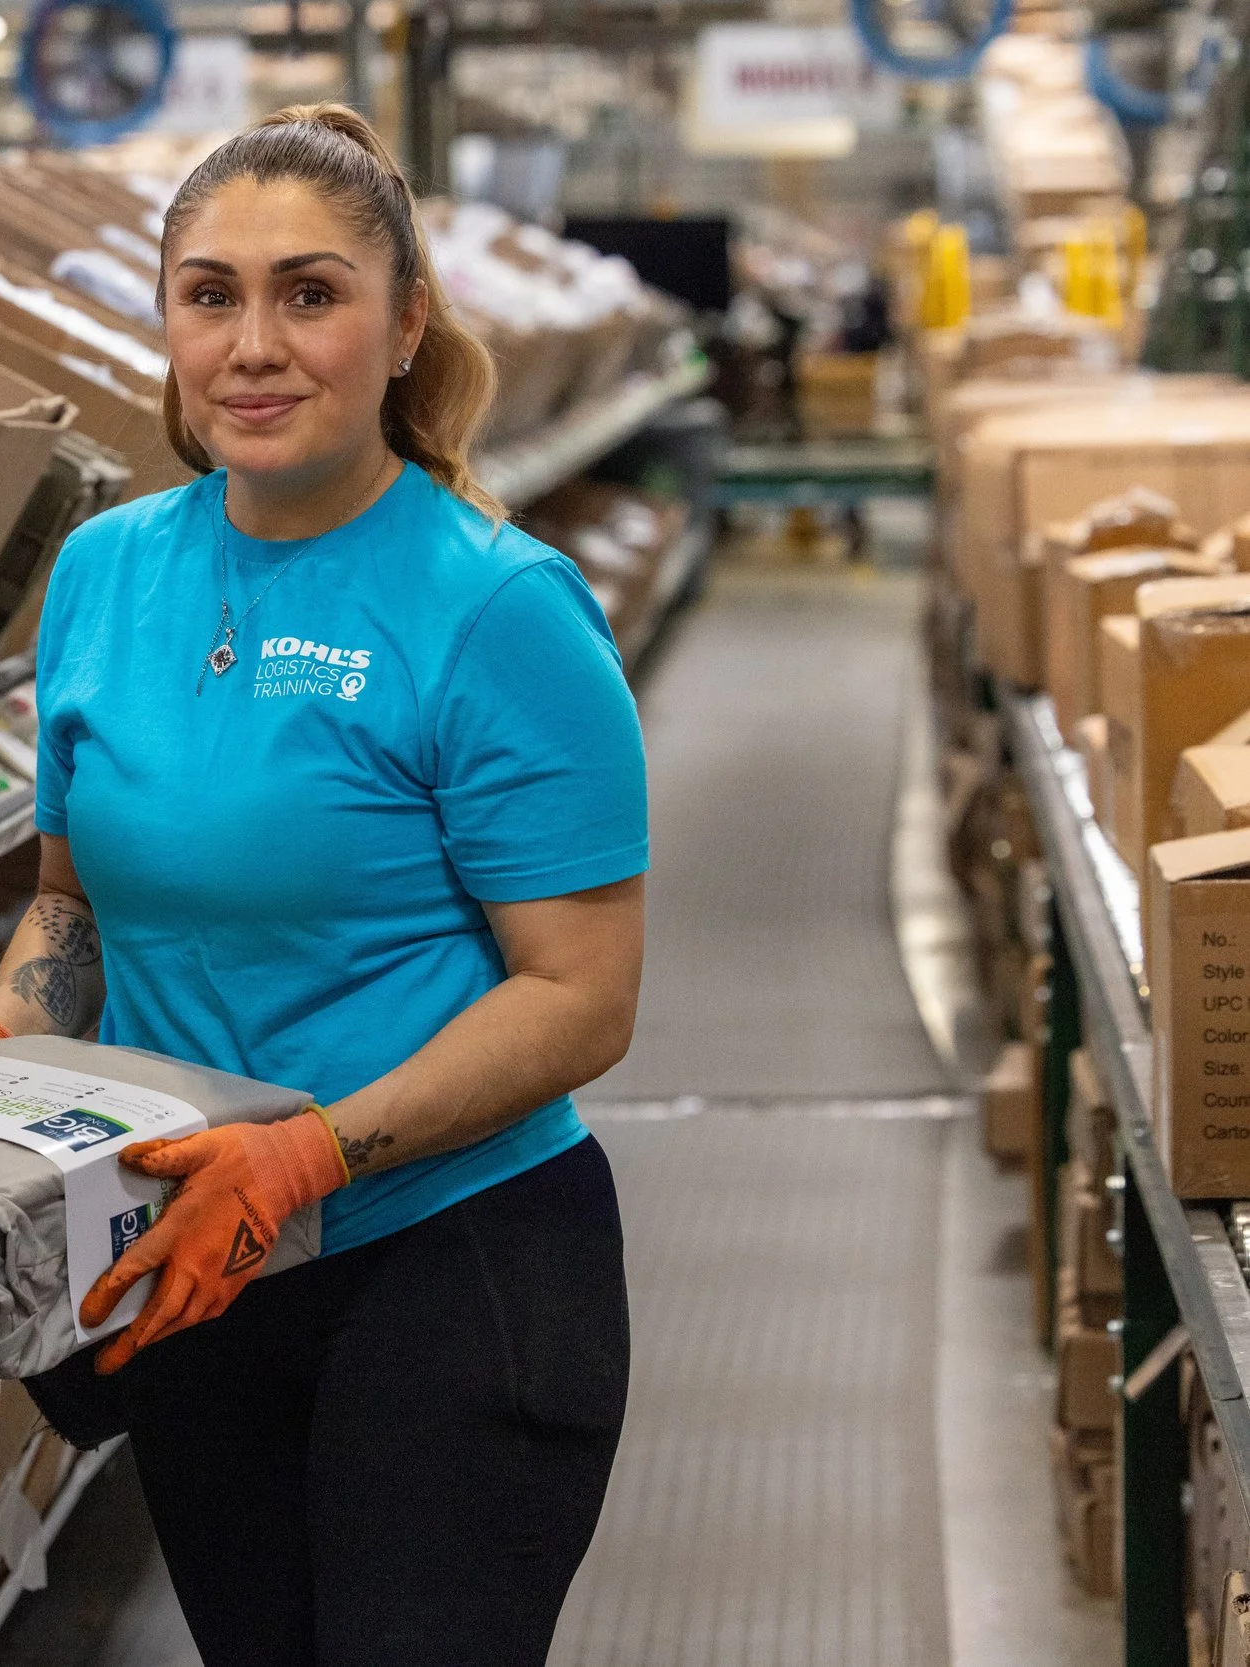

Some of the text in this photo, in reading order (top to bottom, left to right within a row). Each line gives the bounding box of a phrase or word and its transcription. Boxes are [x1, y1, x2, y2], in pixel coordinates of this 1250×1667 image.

[261, 637, 372, 669] KOHL'S
[256, 660, 341, 681] LOGISTICS
[254, 680, 333, 698] TRAINING
[1204, 964, 1245, 982] Style
[1203, 996, 1243, 1012] UPC
[12, 1094, 70, 1110] SHEET
[43, 1115, 110, 1144] BIG
[79, 1115, 108, 1128] ONE
